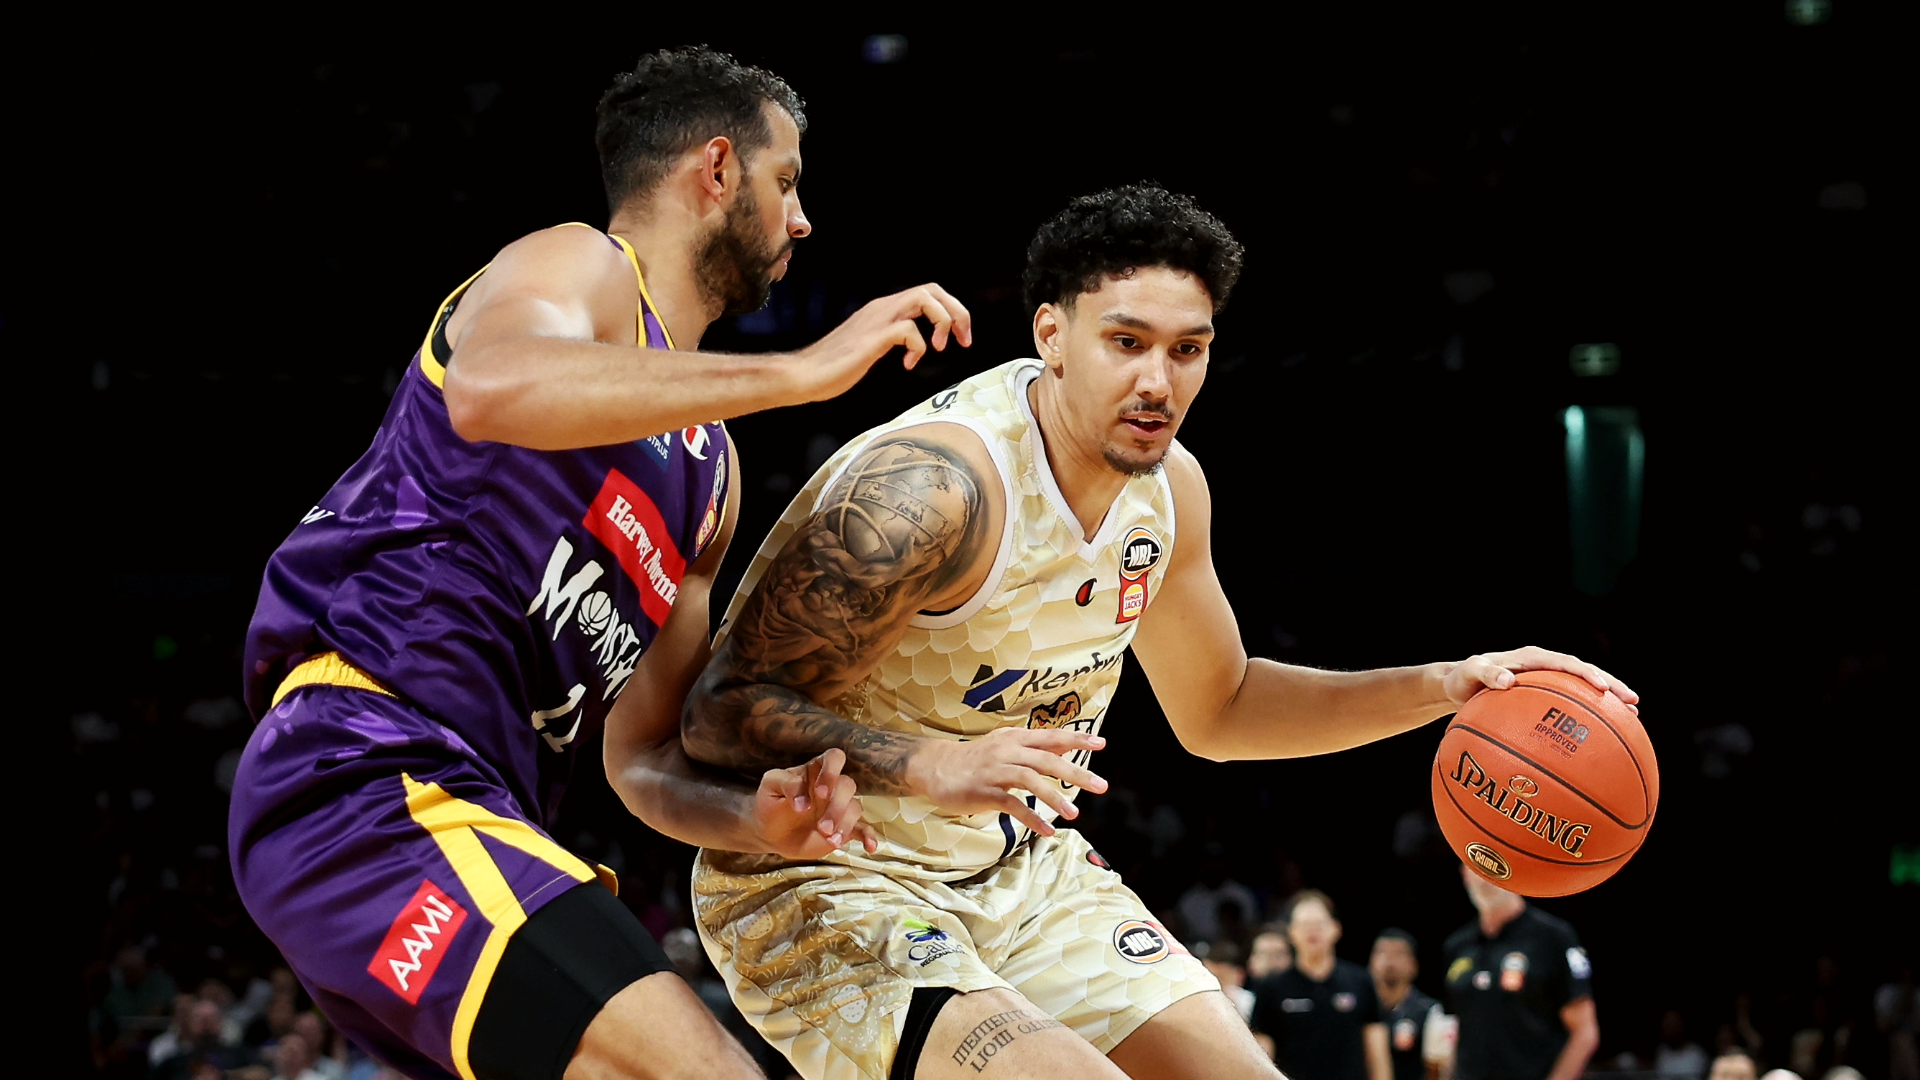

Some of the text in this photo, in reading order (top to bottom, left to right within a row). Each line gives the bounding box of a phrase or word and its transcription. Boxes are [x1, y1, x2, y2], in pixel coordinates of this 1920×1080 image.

[606, 494, 654, 564] Harvey
[1127, 543, 1152, 568] NBL
[1124, 592, 1143, 601] HUNGRY
[1534, 723, 1578, 753] APPROVED
[1541, 706, 1590, 744] FIBA
[1449, 749, 1592, 858] SPALDING
[387, 894, 454, 992] AAMI
[1123, 930, 1160, 954] NBL
